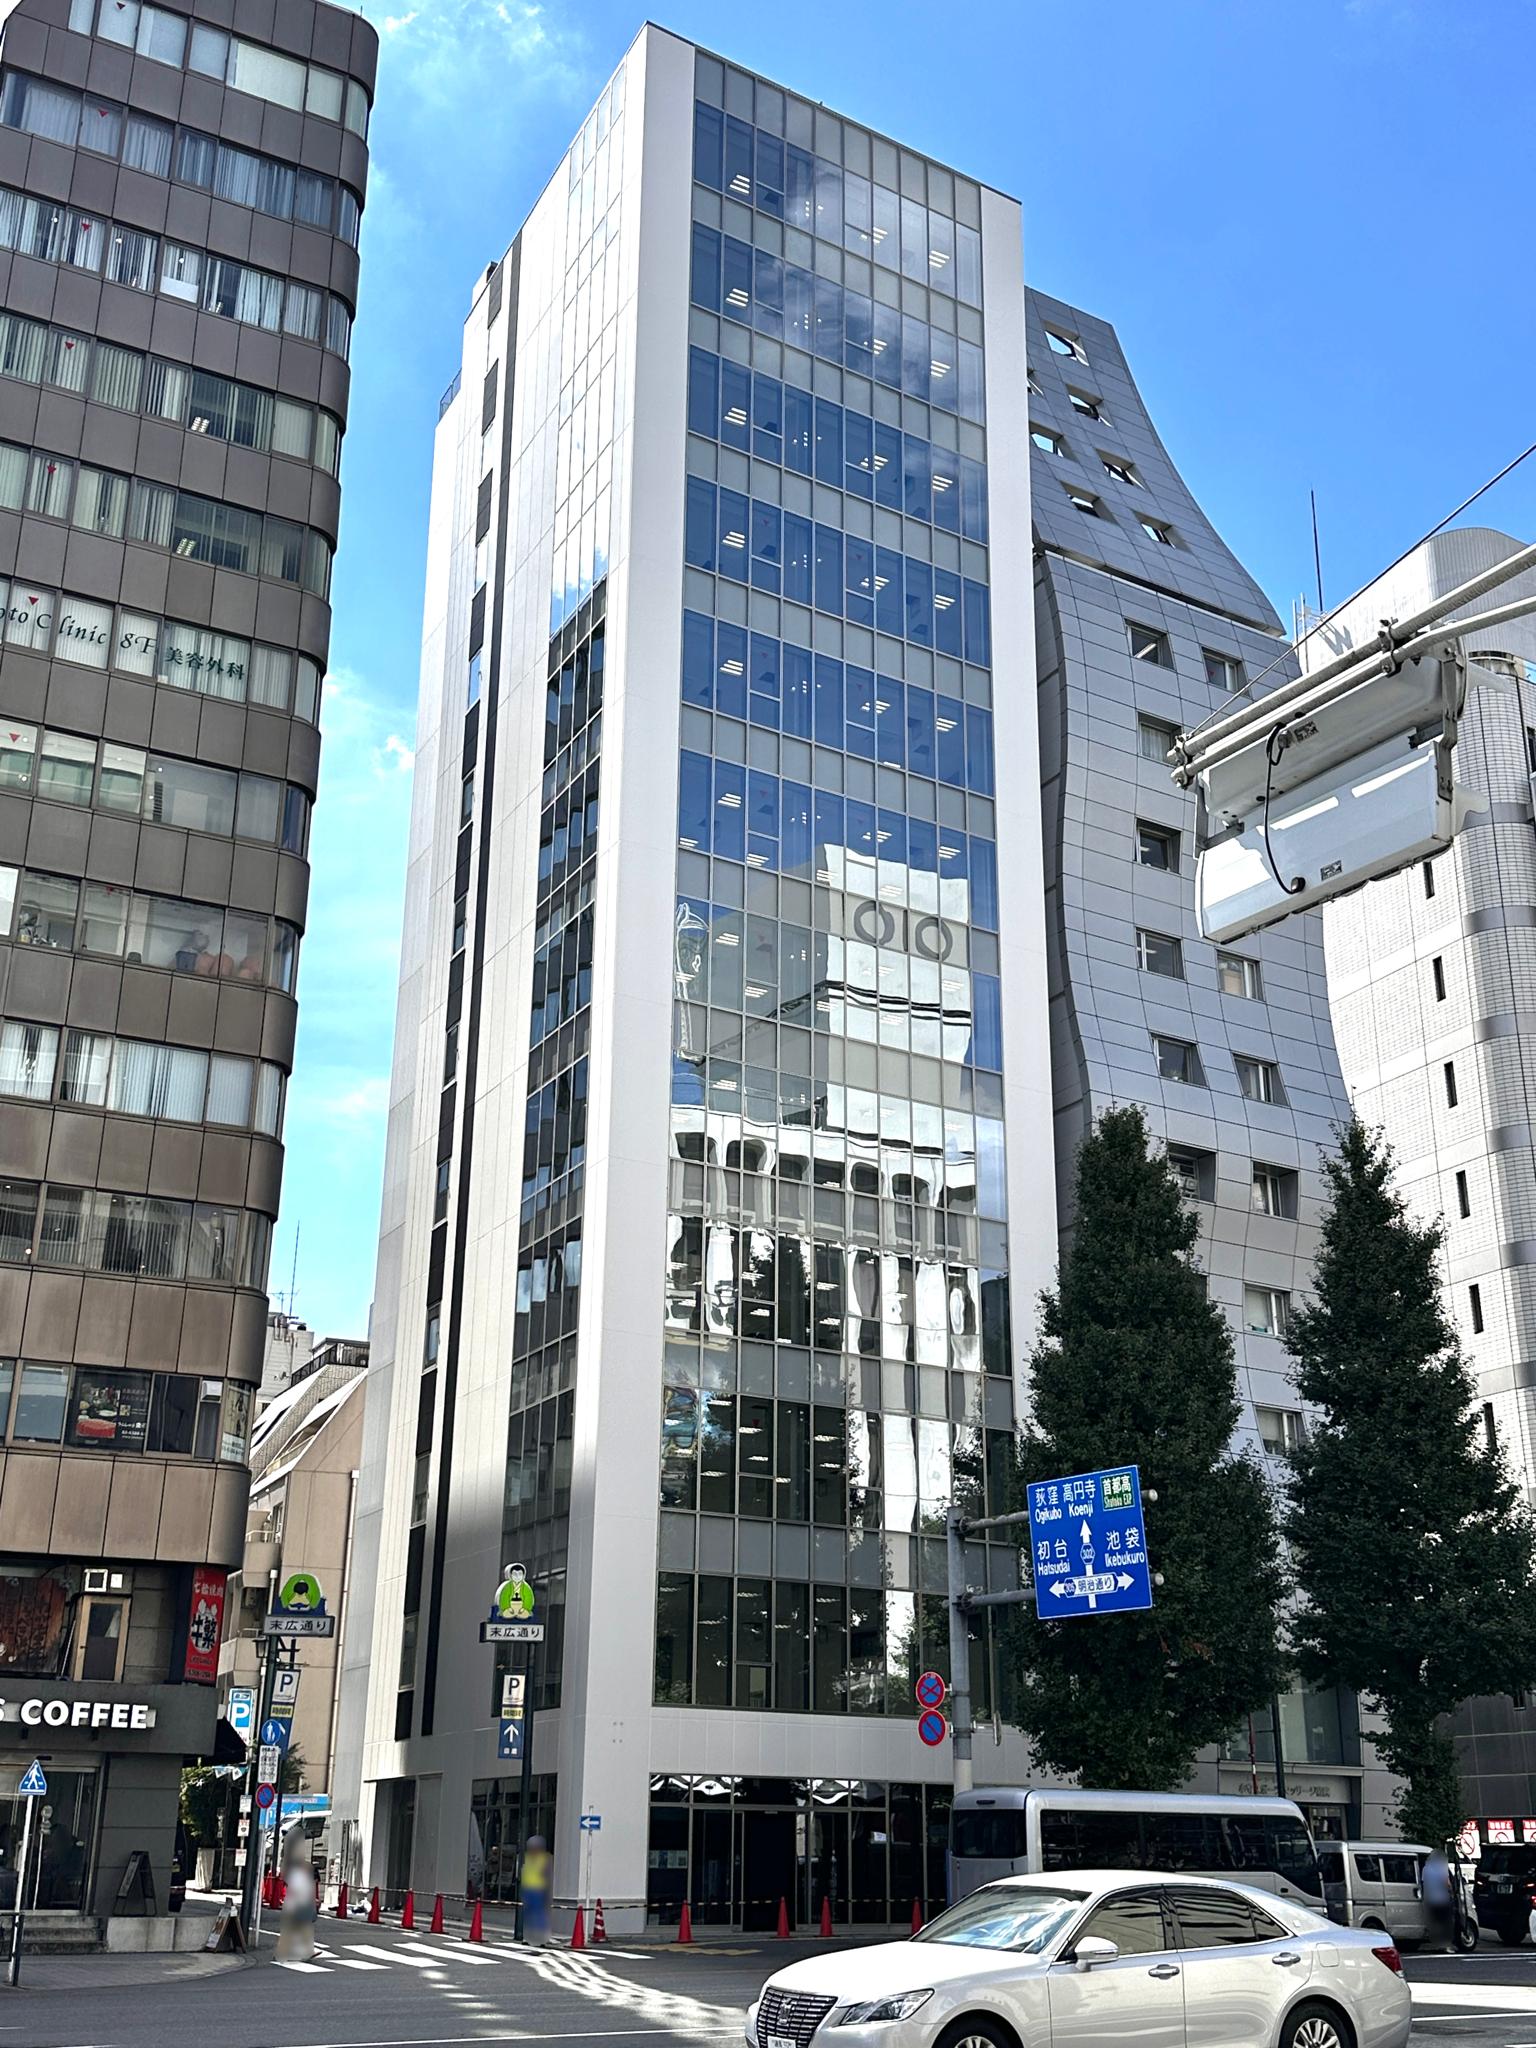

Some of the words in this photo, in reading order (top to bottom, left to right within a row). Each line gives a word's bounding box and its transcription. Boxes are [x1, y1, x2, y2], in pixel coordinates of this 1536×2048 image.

[36, 613, 107, 645] Clinic
[166, 647, 244, 680] 美容外科
[1035, 1486, 1059, 1507] 荻窪
[1062, 1479, 1096, 1502] 高円寺
[1102, 1475, 1131, 1495] 首都高
[1035, 1506, 1063, 1525] Ogikubo
[1068, 1502, 1094, 1518] Koenji
[1037, 1538, 1068, 1560] 初台
[1106, 1528, 1141, 1551] 池袋
[1038, 1560, 1071, 1576] Hatsudai
[1105, 1551, 1145, 1568] Ikebukuro
[1077, 1576, 1113, 1593] 明治通り
[269, 1619, 326, 1632] 末広通り
[489, 1626, 541, 1639] 末広通り
[280, 1673, 294, 1692] P
[508, 1677, 520, 1696] P
[20, 1699, 149, 1730] COFFEE
[231, 1702, 250, 1728] P
